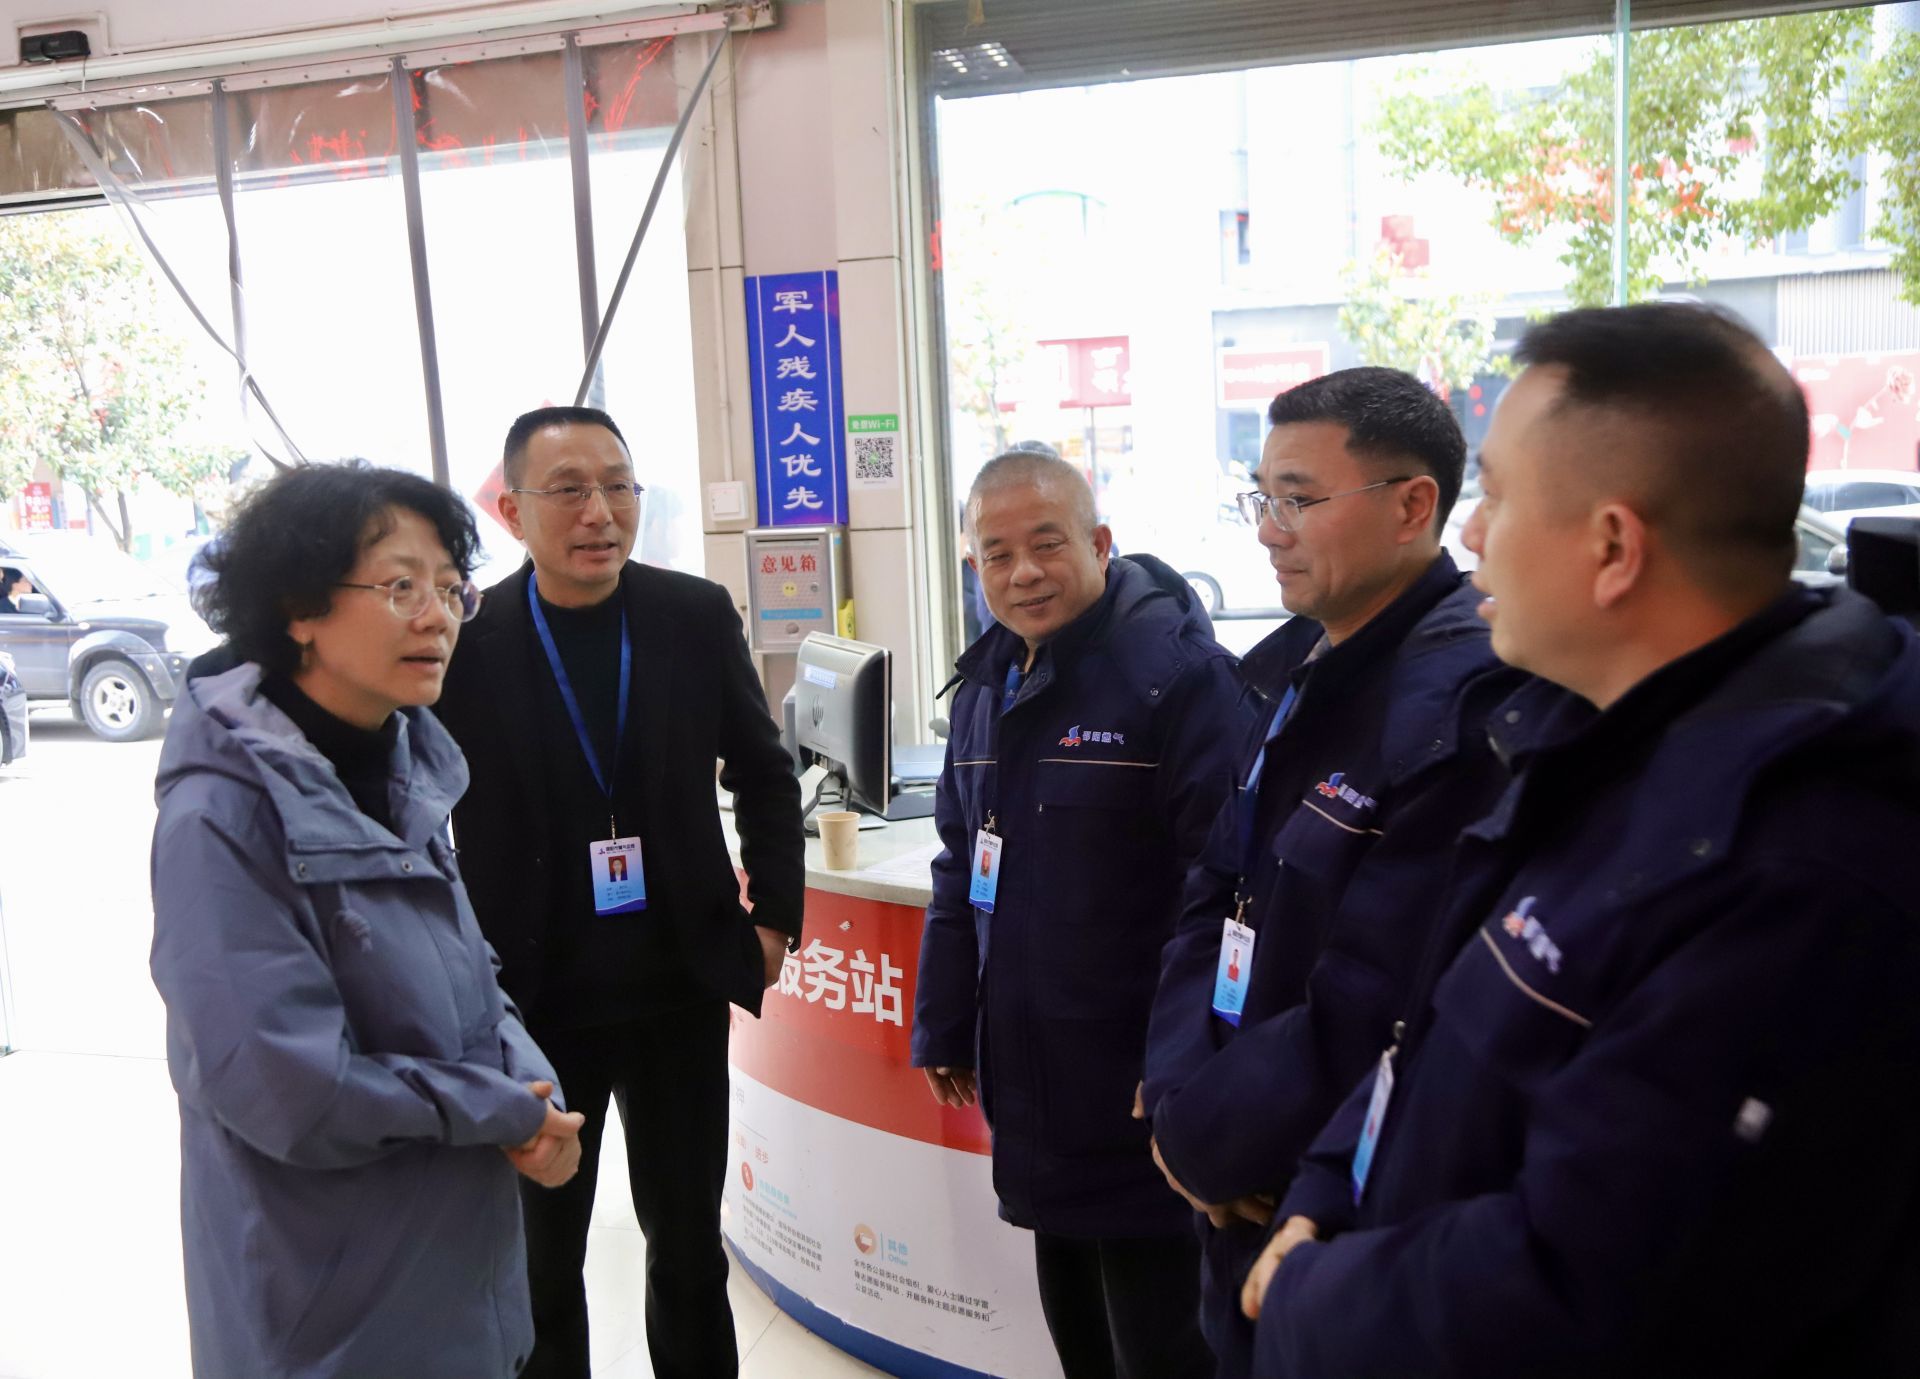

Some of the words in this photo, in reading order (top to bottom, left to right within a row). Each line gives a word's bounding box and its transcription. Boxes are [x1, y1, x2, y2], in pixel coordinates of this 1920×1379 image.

[772, 290, 823, 509] 军人残疾人优先
[761, 553, 816, 574] 意见箱
[887, 1238, 909, 1256] 其他
